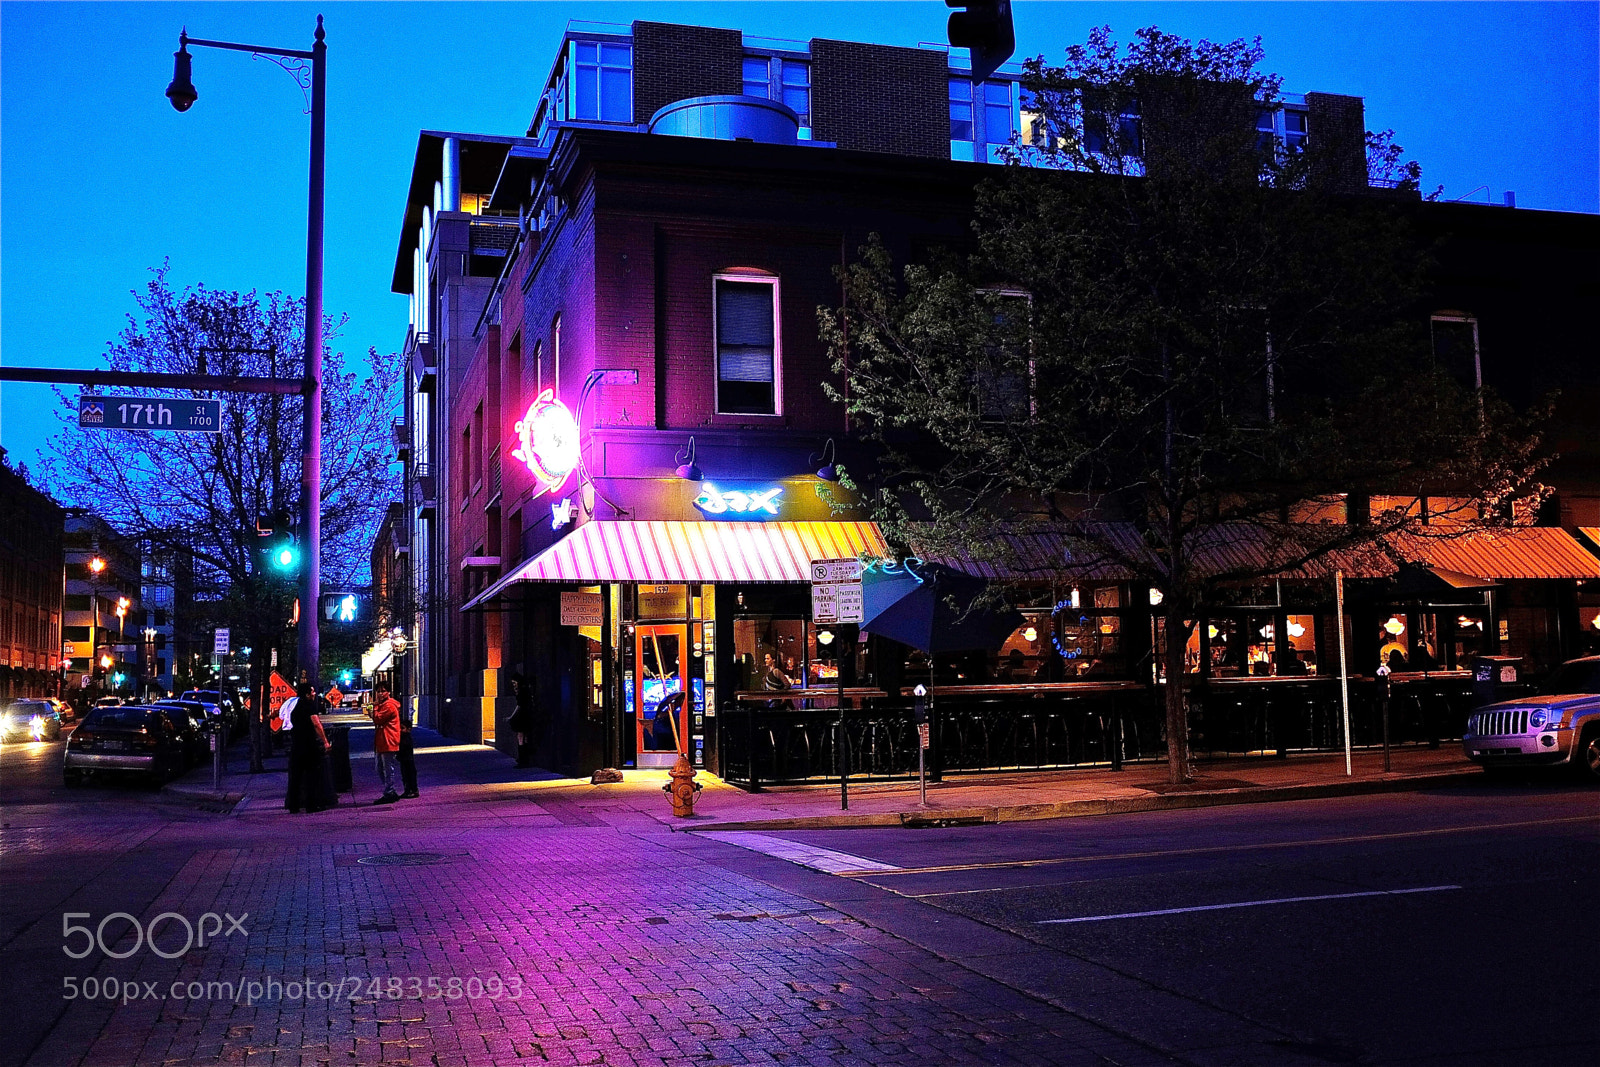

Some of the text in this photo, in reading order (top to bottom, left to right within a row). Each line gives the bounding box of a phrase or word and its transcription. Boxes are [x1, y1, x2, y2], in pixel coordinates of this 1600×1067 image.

[118, 403, 172, 425] 17th
[196, 406, 206, 415] St
[81, 414, 104, 423] DENVER
[189, 416, 212, 426] 1700
[819, 587, 830, 595] NO
[561, 595, 601, 604] HAPPY HOUR
[814, 595, 836, 603] PARKING
[577, 616, 602, 624] OYSTERS
[269, 685, 288, 694] OAD
[269, 696, 287, 705] ORK
